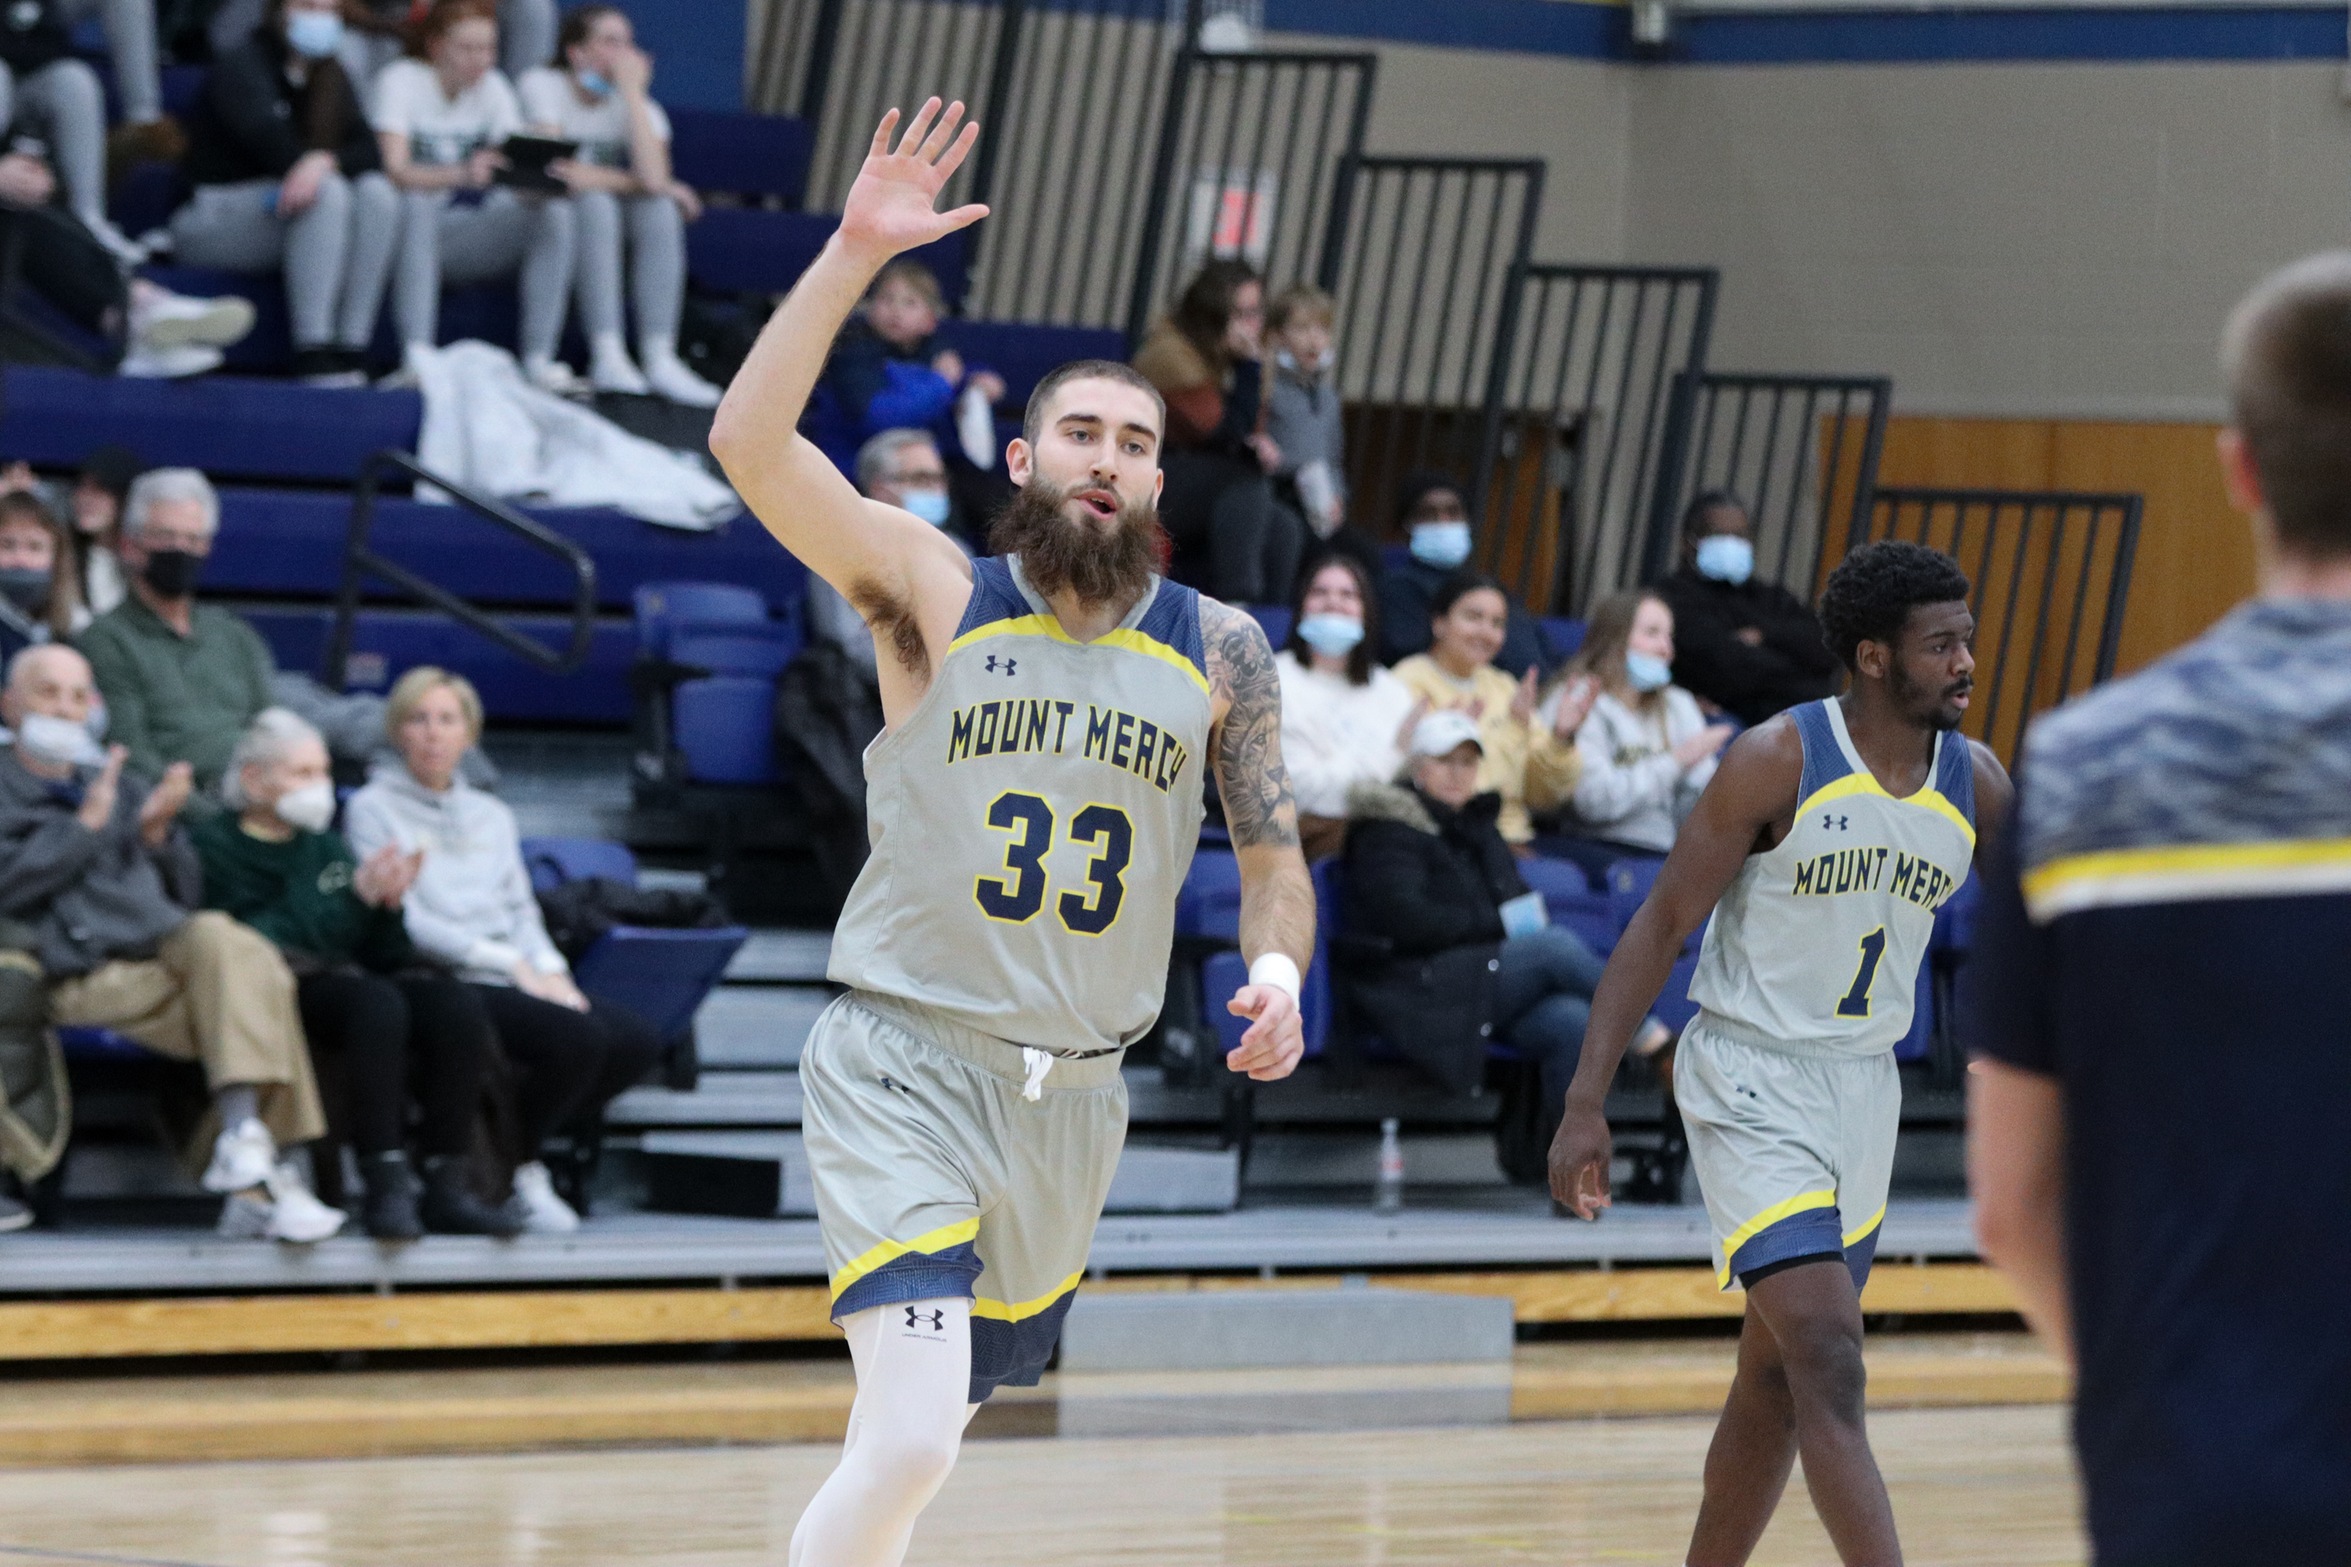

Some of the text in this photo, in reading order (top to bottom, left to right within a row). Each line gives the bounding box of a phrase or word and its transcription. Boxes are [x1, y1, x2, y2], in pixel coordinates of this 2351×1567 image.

[946, 698, 1188, 795] MOUNT MERCY
[972, 787, 1136, 939] 33
[1791, 846, 1889, 897] MOUNT
[1834, 923, 1888, 1019] 1
